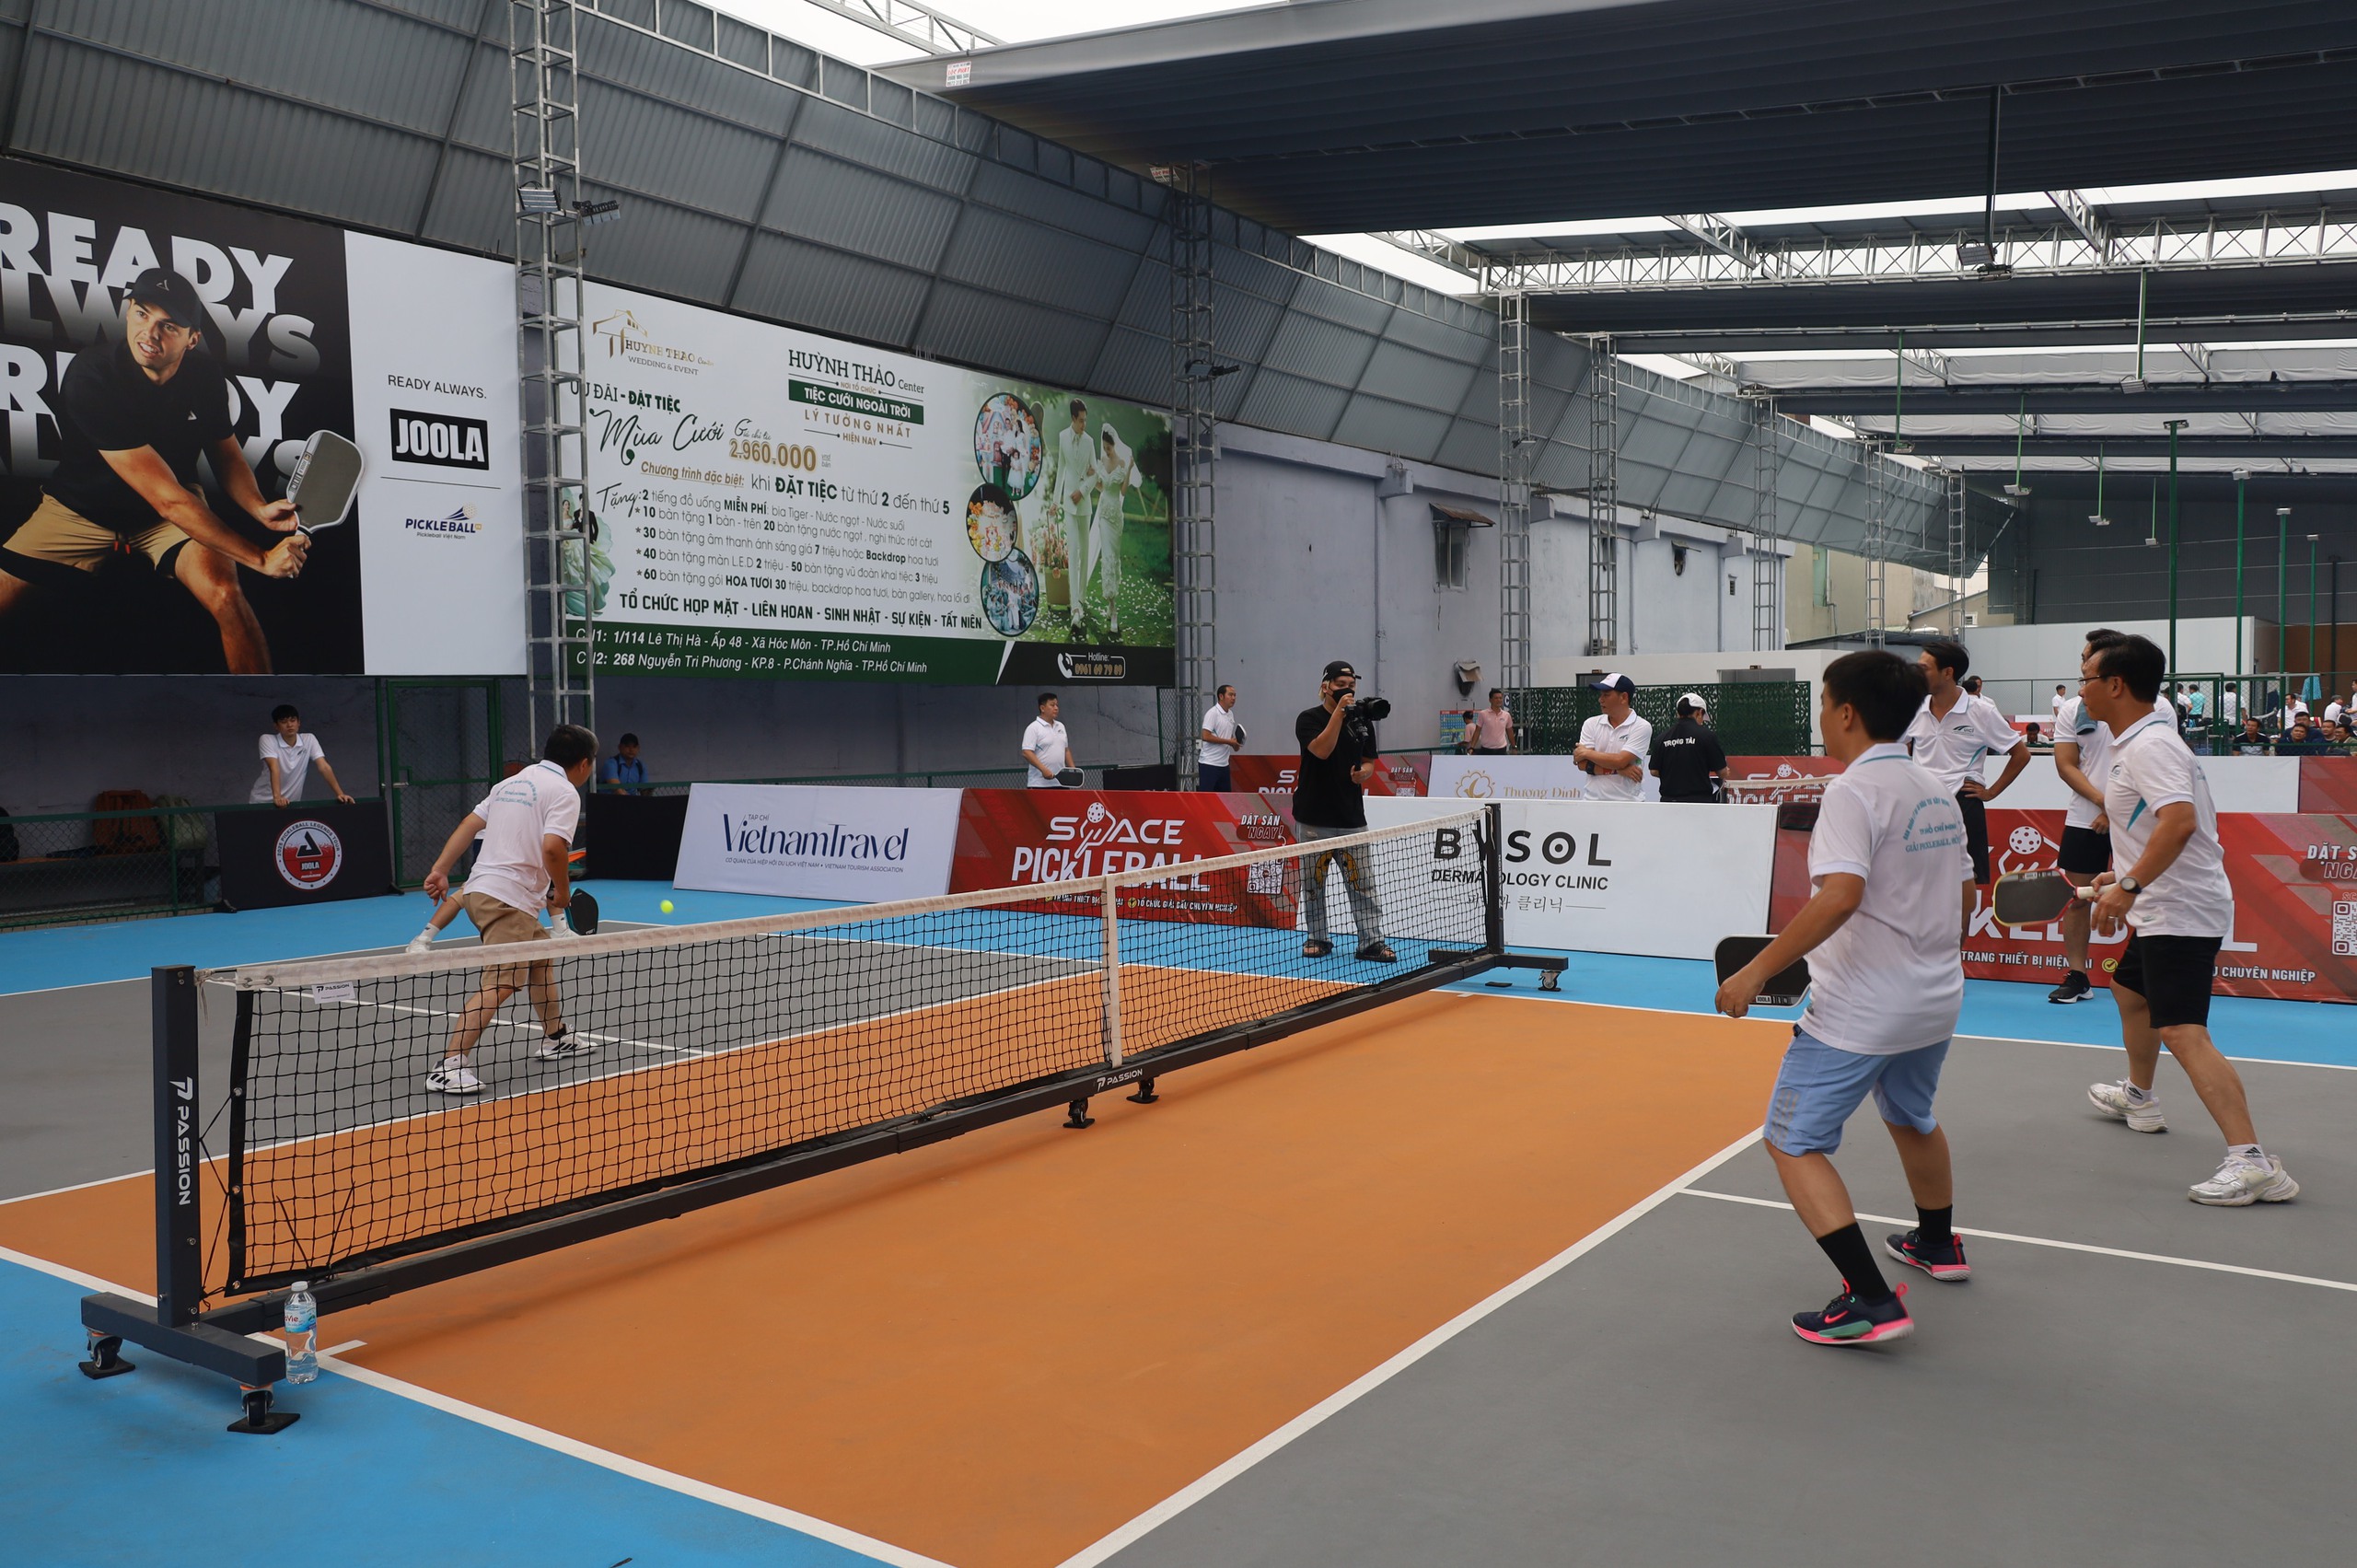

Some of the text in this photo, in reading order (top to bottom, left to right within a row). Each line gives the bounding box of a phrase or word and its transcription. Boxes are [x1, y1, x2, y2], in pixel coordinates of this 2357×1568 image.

[628, 355, 699, 376] WEDDING EVENT
[788, 348, 924, 394] HUỲNH THẢO Center
[388, 374, 487, 400] READY ALWAYS.
[628, 389, 680, 415] ĐẶT TIỆC
[804, 386, 911, 419] TIỆC CƯỚI NGOÀI TRỜI
[805, 408, 911, 438] LÝ NHẤT
[396, 418, 485, 462] JOOLA
[588, 408, 725, 466] Mùa Cưới
[729, 437, 817, 471] 2.960.000
[641, 460, 950, 515] Chương trình đặc biệt: khi ĐẶT TIỆC từ thứ 2 đến thứ 5
[643, 505, 818, 539] 10 bàn tặng bàn 20 bàn tặng
[651, 489, 888, 529] tiếng uống MIỄN Tiger Nước Nước
[405, 518, 476, 533] PICKLEBALL
[643, 527, 906, 564] 30 bàn tặng âm thanh sáng hoặc Backdrop
[643, 548, 879, 579] 40 bàn tặng màn triệu 50 bàn tặng đoàn
[644, 568, 872, 597] 60 bàn tặng HOA TƯƠI 30 backdrop hoa
[620, 587, 982, 630] TỔ CHỨC HỌP MẶT LIÊN HOAN SINH NHẬT SỰ KIỆN TẤT NIÊN
[613, 630, 891, 653] 1/114 Lê Thị Hà Ấp 48 Xã Hóc Môn TP.Hồ Chí Minh
[613, 652, 927, 673] 268 Nguyễn Tri Phương KP.8 P.Chánh Nghĩa TP.Hồ Chí Minh
[1663, 738, 1684, 748] TRỌNG
[1241, 812, 1281, 829] ĐẶT SÂN
[1248, 825, 1284, 840] NGAY!
[282, 822, 309, 842] PICKLEBALL
[309, 822, 334, 836] LEGENDS
[331, 836, 341, 852] TOUR
[724, 813, 910, 861] VietnamTravel
[301, 861, 320, 870] JOOLA
[2307, 842, 2341, 865] ĐẶT
[1555, 875, 1608, 890] CLINIC
[1517, 894, 1563, 913] 클리닉
[1961, 950, 1995, 963] TRANG
[1999, 951, 2029, 965] THIẾT
[2032, 954, 2043, 969] BỊ
[2222, 966, 2268, 980] CHUYÊN
[2271, 969, 2316, 985] NGHIỆP
[1107, 1068, 1143, 1086] PASSION
[177, 1105, 191, 1206] PASSION
